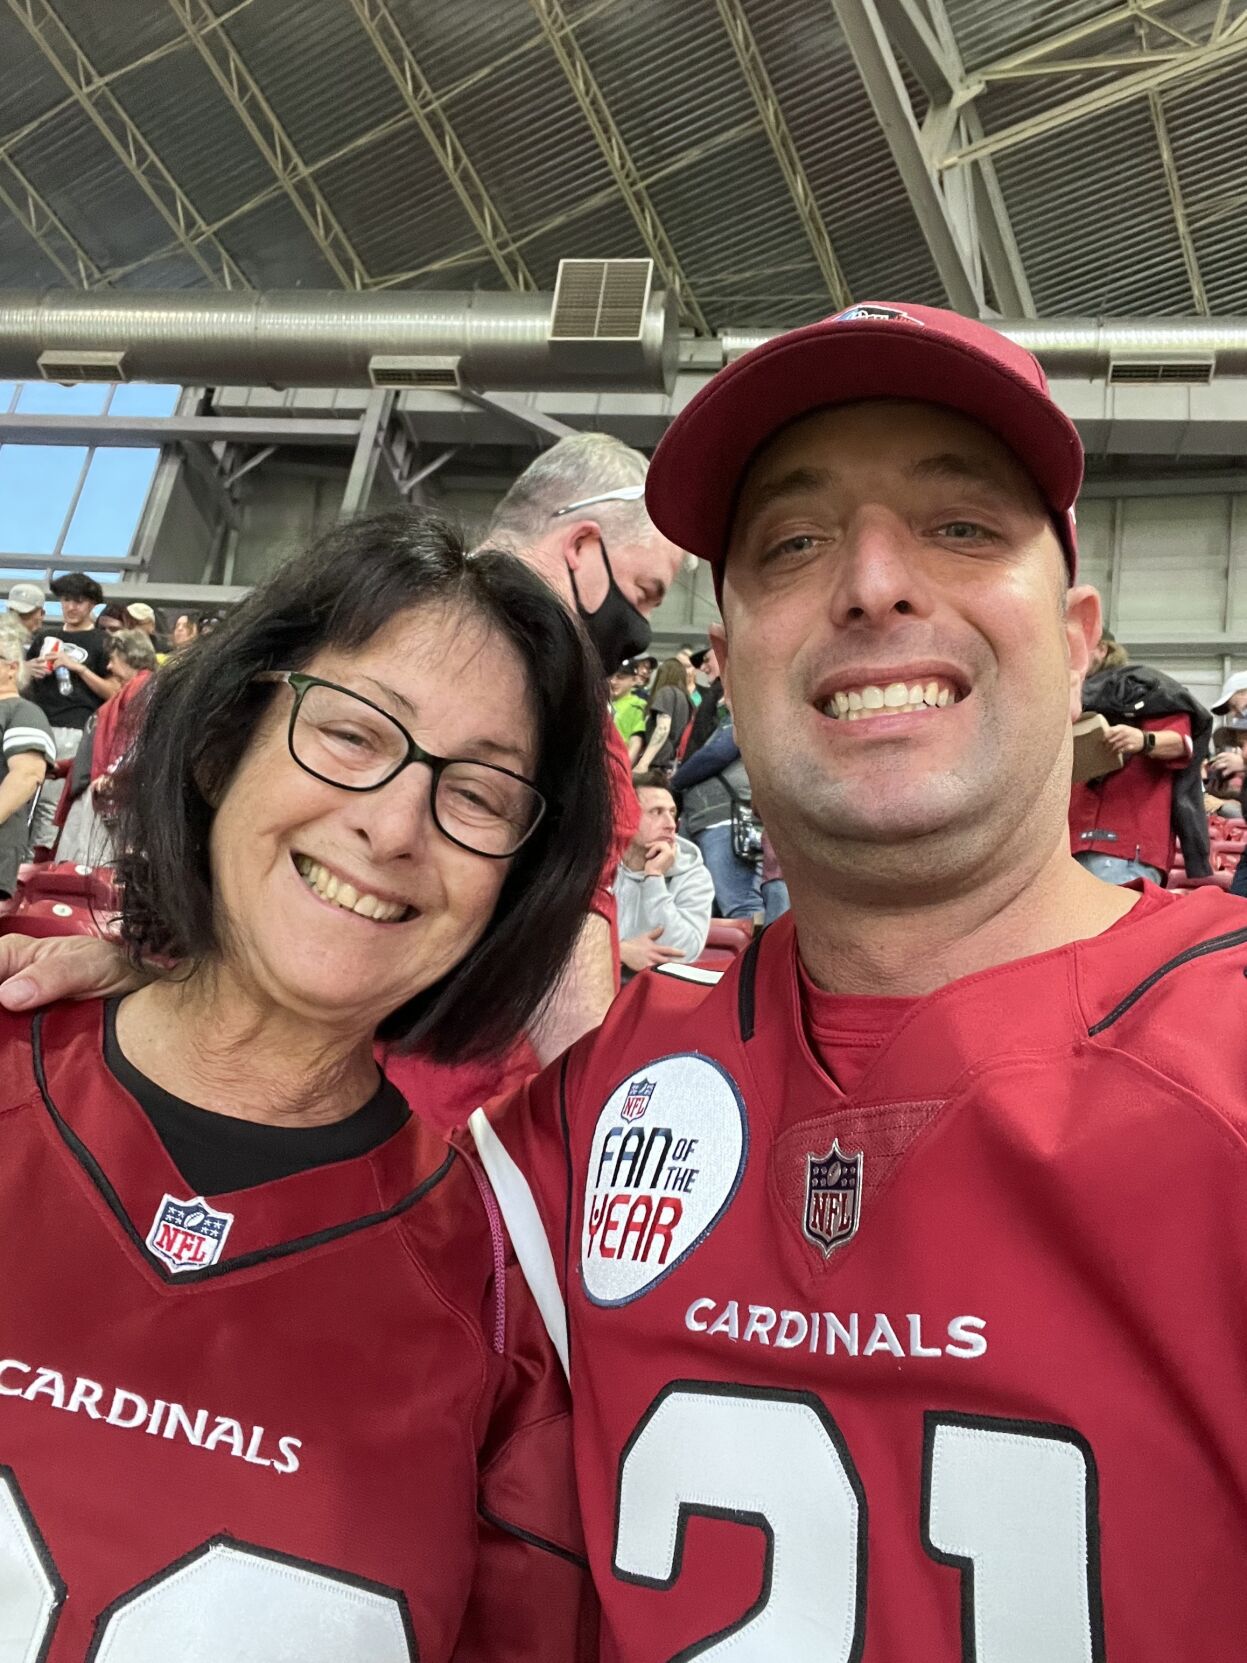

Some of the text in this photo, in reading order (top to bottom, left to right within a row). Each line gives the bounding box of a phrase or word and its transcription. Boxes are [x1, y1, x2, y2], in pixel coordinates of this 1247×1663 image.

[622, 1096, 646, 1117] NFL
[596, 1127, 673, 1189] FAN
[672, 1138, 699, 1162] OF
[664, 1166, 700, 1193] THE
[587, 1193, 684, 1265] YEAR
[810, 1192, 851, 1238] NFL
[155, 1223, 207, 1263] NFL
[684, 1297, 988, 1359] CARDINALS
[0, 1359, 303, 1474] CARDINALS
[611, 1379, 1107, 1663] 21
